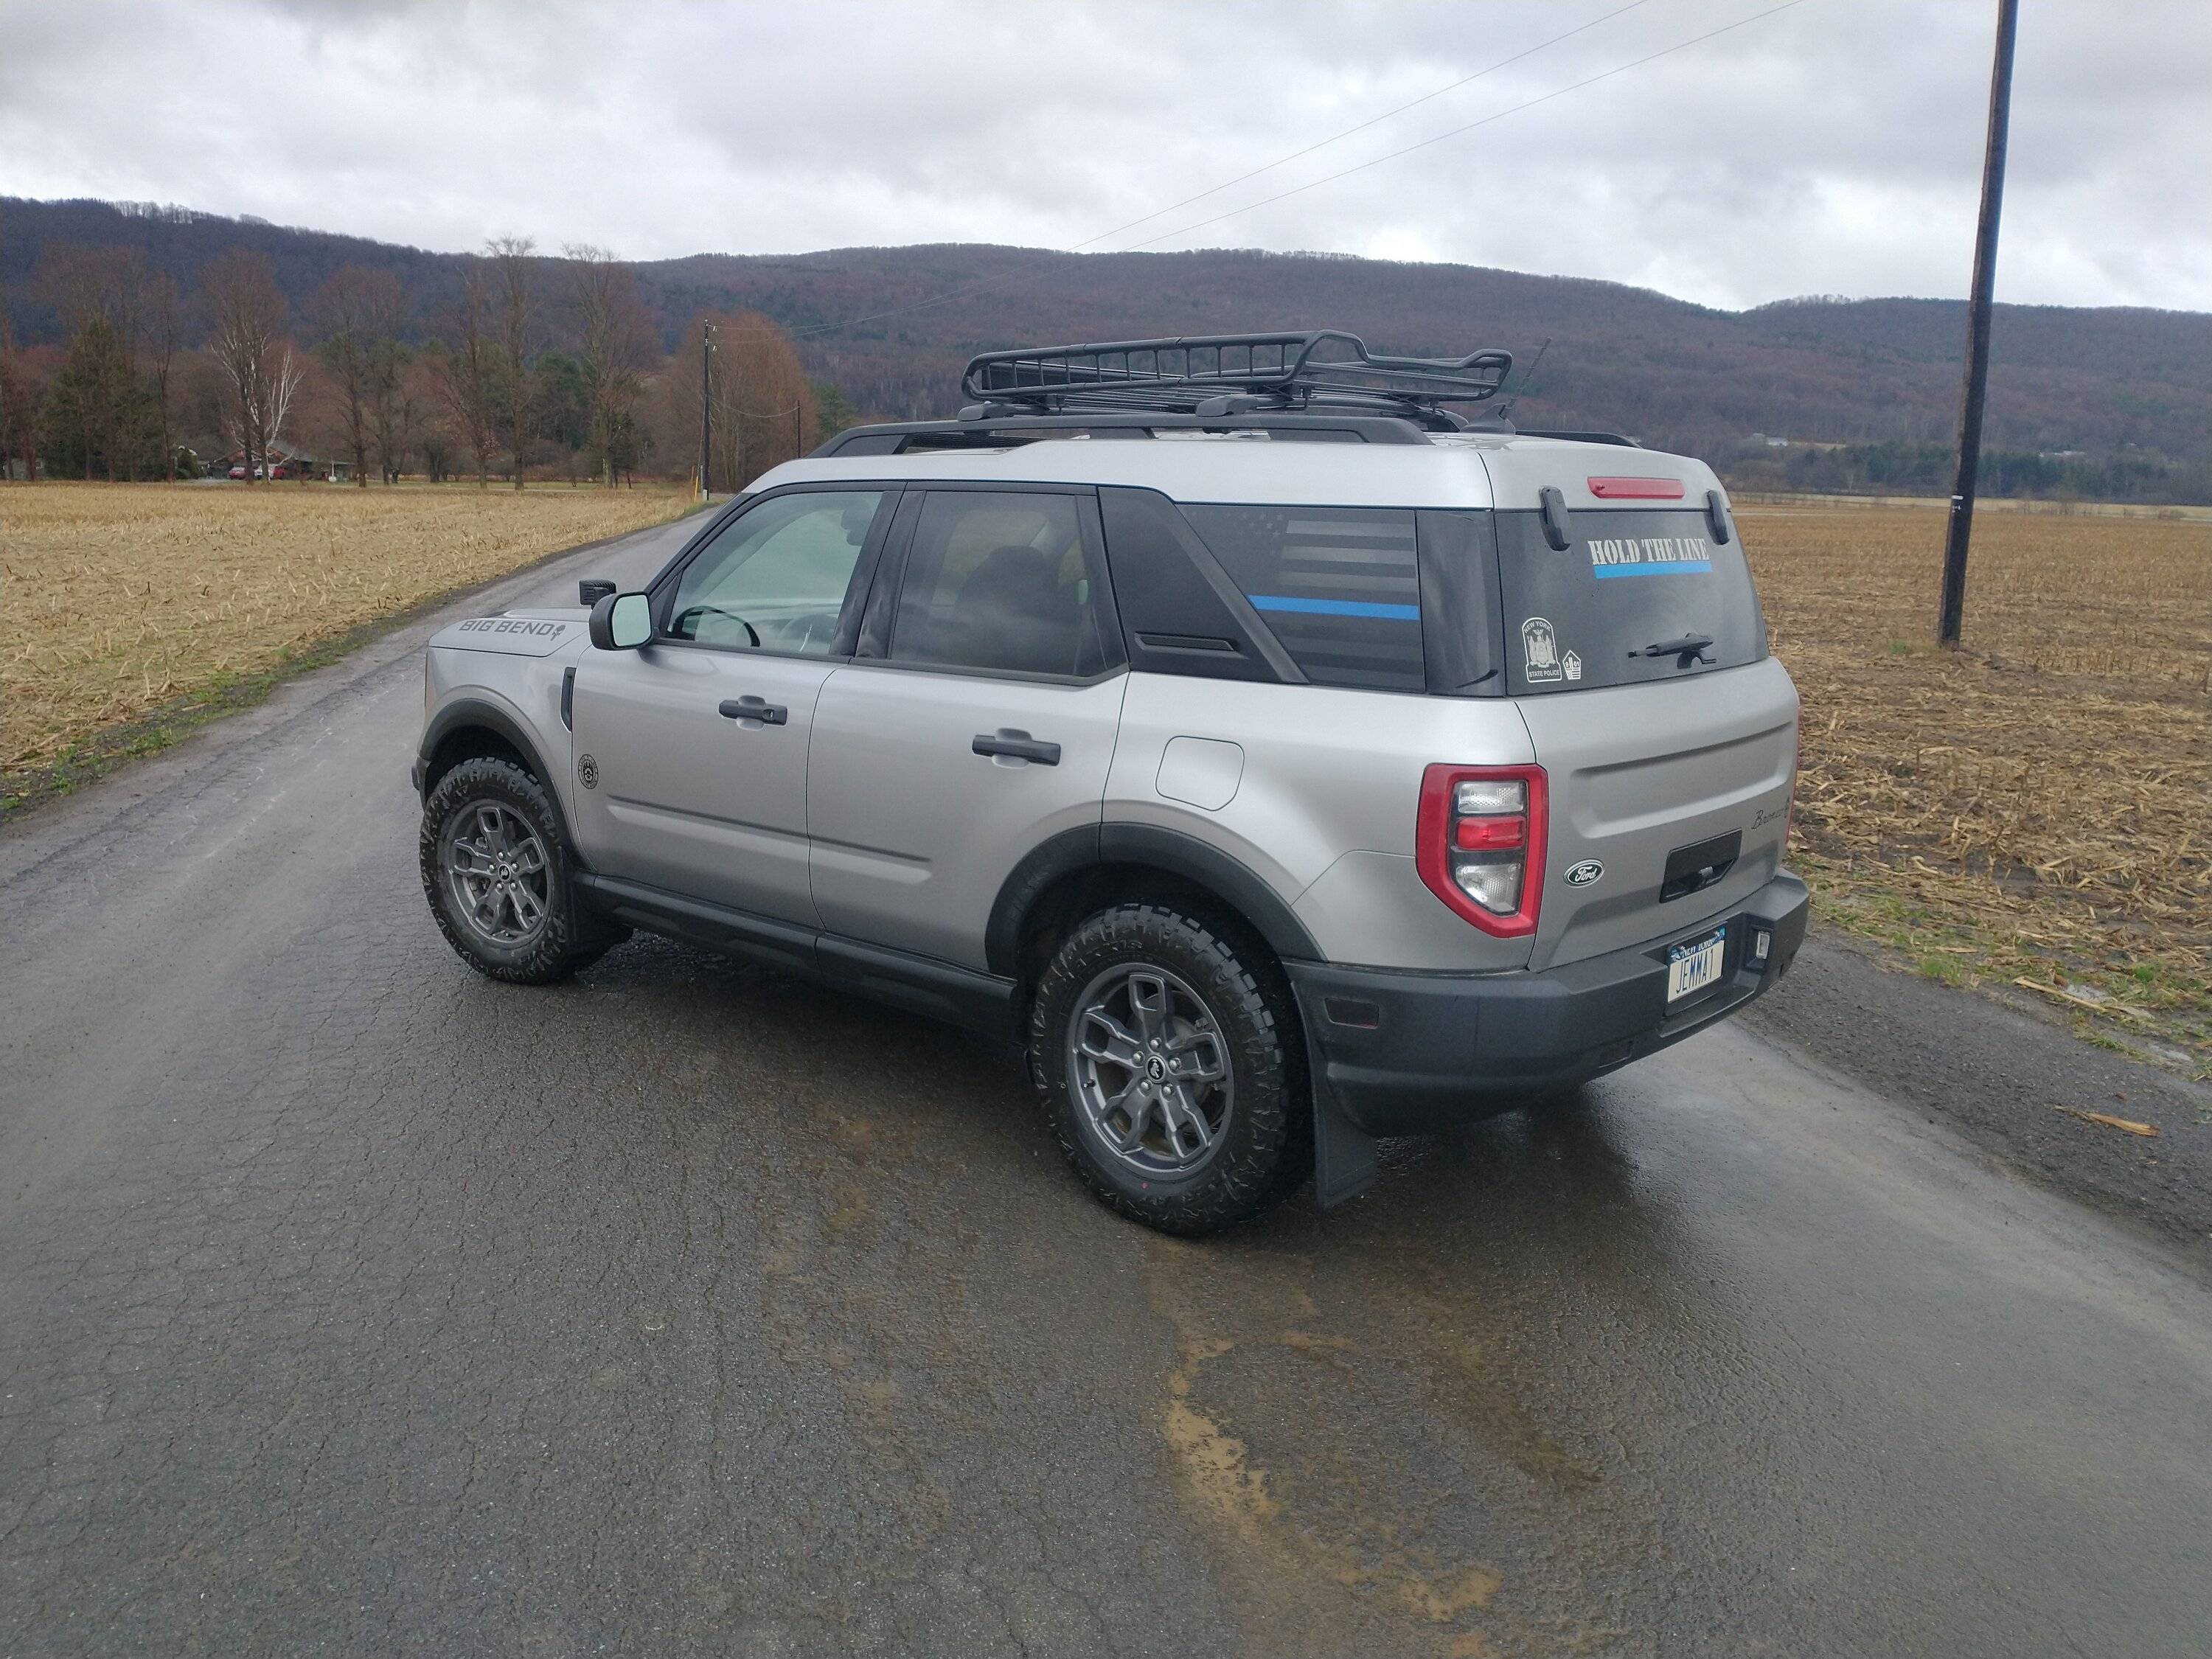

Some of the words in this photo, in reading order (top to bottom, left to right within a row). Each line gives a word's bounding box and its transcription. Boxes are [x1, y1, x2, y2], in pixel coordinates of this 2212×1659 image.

[1587, 540, 1641, 565] HOLD
[1641, 538, 1676, 562] THE
[1676, 538, 1710, 560] LINE
[459, 620, 495, 632] BIG
[494, 621, 555, 635] BEND
[1524, 622, 1534, 633] NEW
[1536, 621, 1551, 631] YORK
[1574, 866, 1598, 882] Ford
